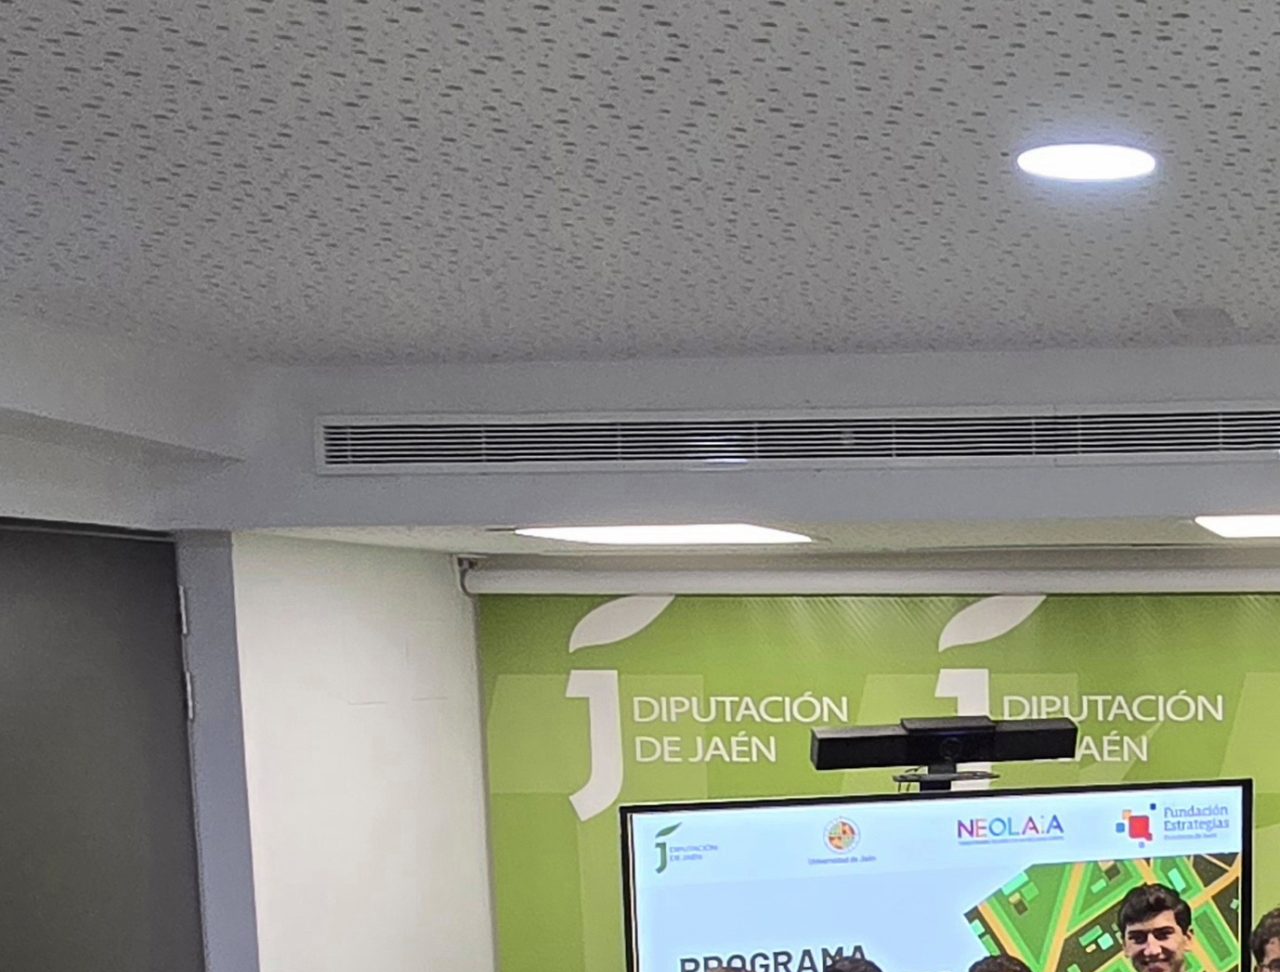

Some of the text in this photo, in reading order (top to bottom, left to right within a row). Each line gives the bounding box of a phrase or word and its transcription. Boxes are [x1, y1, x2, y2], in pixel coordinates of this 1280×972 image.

[632, 691, 849, 722] DIPUTACIÓN
[1002, 690, 1224, 722] DIPUTACIÓN
[634, 731, 776, 763] DE JAÉN
[1074, 730, 1149, 762] AÉN
